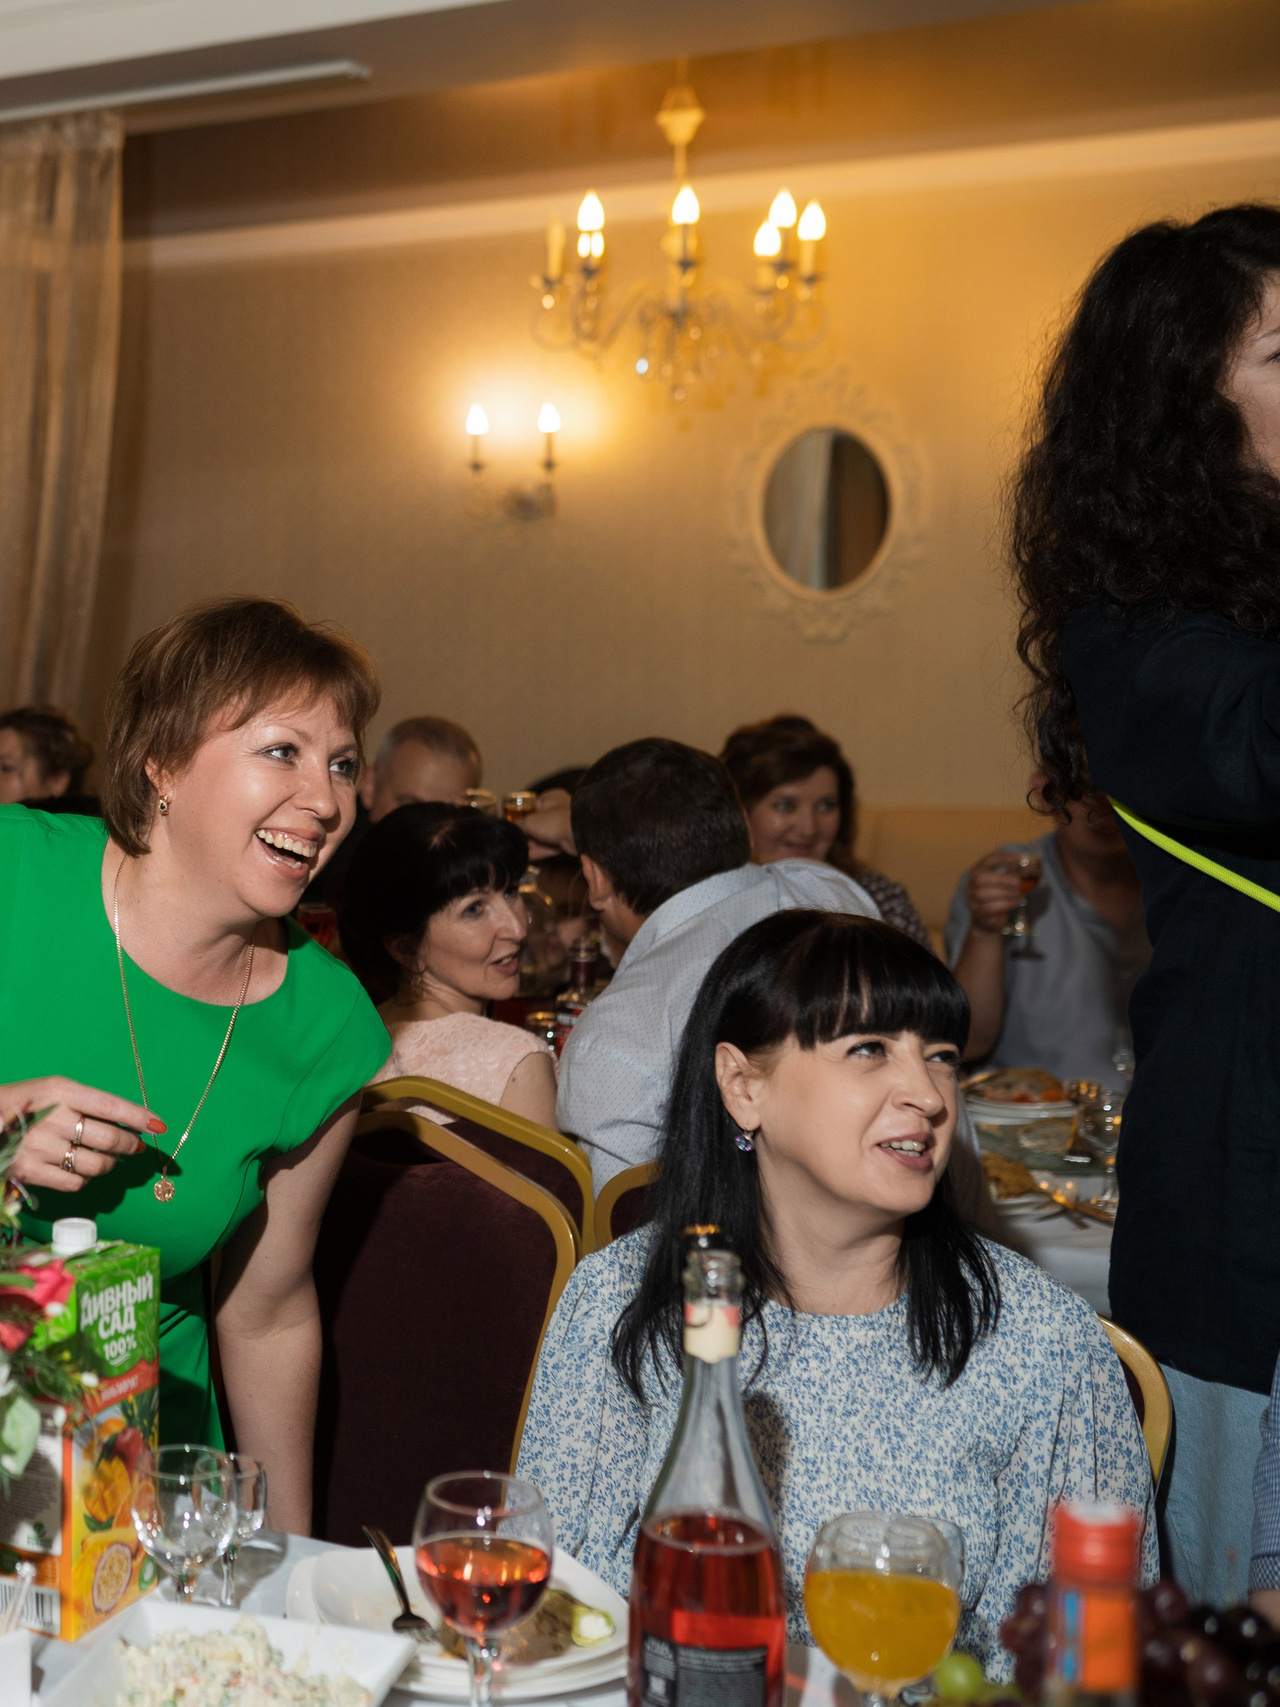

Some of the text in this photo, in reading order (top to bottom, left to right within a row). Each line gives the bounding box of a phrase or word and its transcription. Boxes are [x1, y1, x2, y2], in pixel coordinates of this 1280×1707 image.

[80, 1271, 154, 1332] ДИВНЫЙ
[98, 1306, 136, 1340] САД
[103, 1334, 137, 1361] 100%
